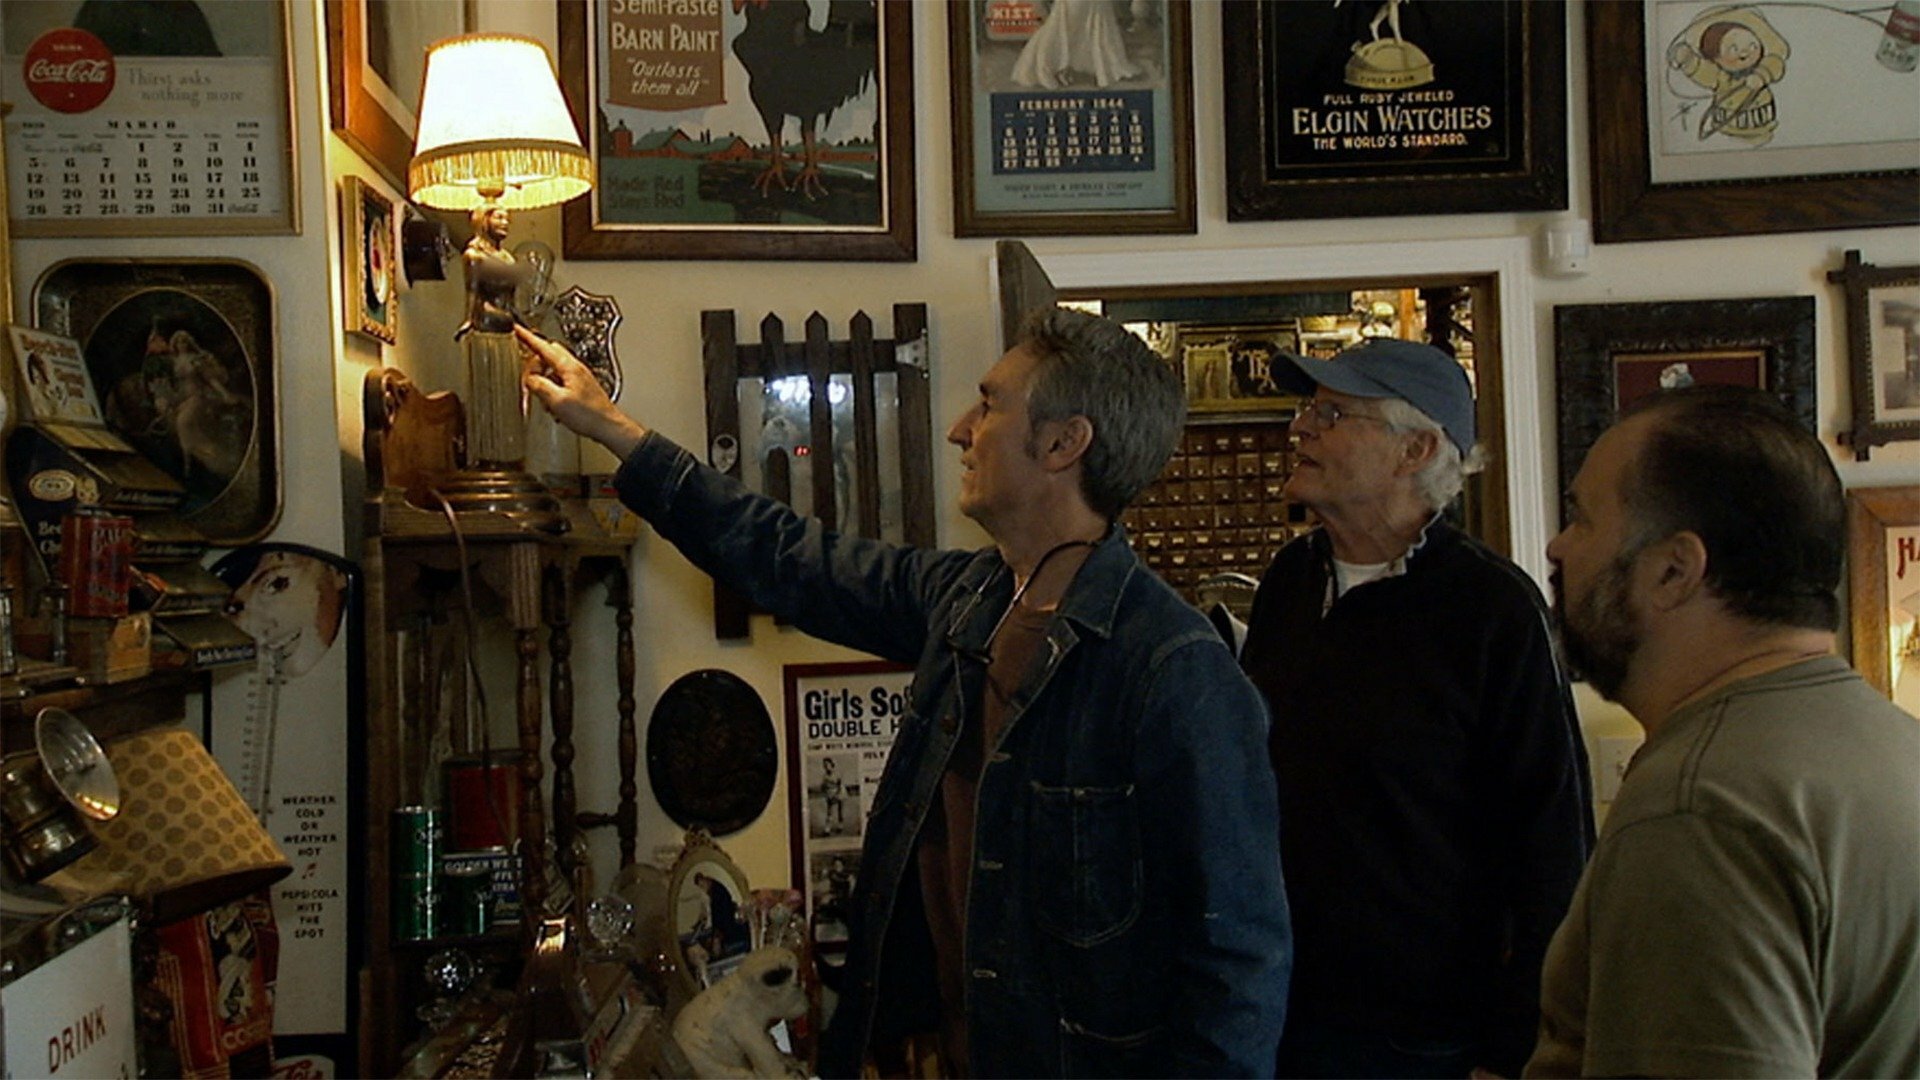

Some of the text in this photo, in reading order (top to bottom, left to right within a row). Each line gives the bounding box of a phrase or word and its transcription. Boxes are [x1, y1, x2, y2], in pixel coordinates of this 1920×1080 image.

[612, 21, 720, 52] BARN PAINT
[127, 67, 211, 84] Thirst asks
[631, 79, 672, 96] them
[142, 86, 243, 107] nothing more
[1323, 89, 1455, 106] FULL RUBY JEWELED
[1019, 98, 1085, 110] FEBRUARY
[1291, 104, 1493, 136] ELGIN WATCHES
[1313, 137, 1337, 150] THE
[1343, 134, 1398, 149] WORLD'S
[206, 157, 222, 167] 10
[27, 173, 43, 183] 12
[207, 172, 222, 182] 17
[805, 688, 863, 720] Girls
[809, 719, 881, 738] DOUBLE
[283, 796, 336, 805] WEATHER
[296, 808, 325, 818] COLD
[301, 821, 319, 831] OR
[284, 834, 337, 843] WEATHER
[298, 847, 321, 856] HOT
[297, 903, 323, 912] HITS
[300, 916, 320, 924] THE
[295, 929, 324, 938] SPOT
[49, 1005, 105, 1074] DRINK
